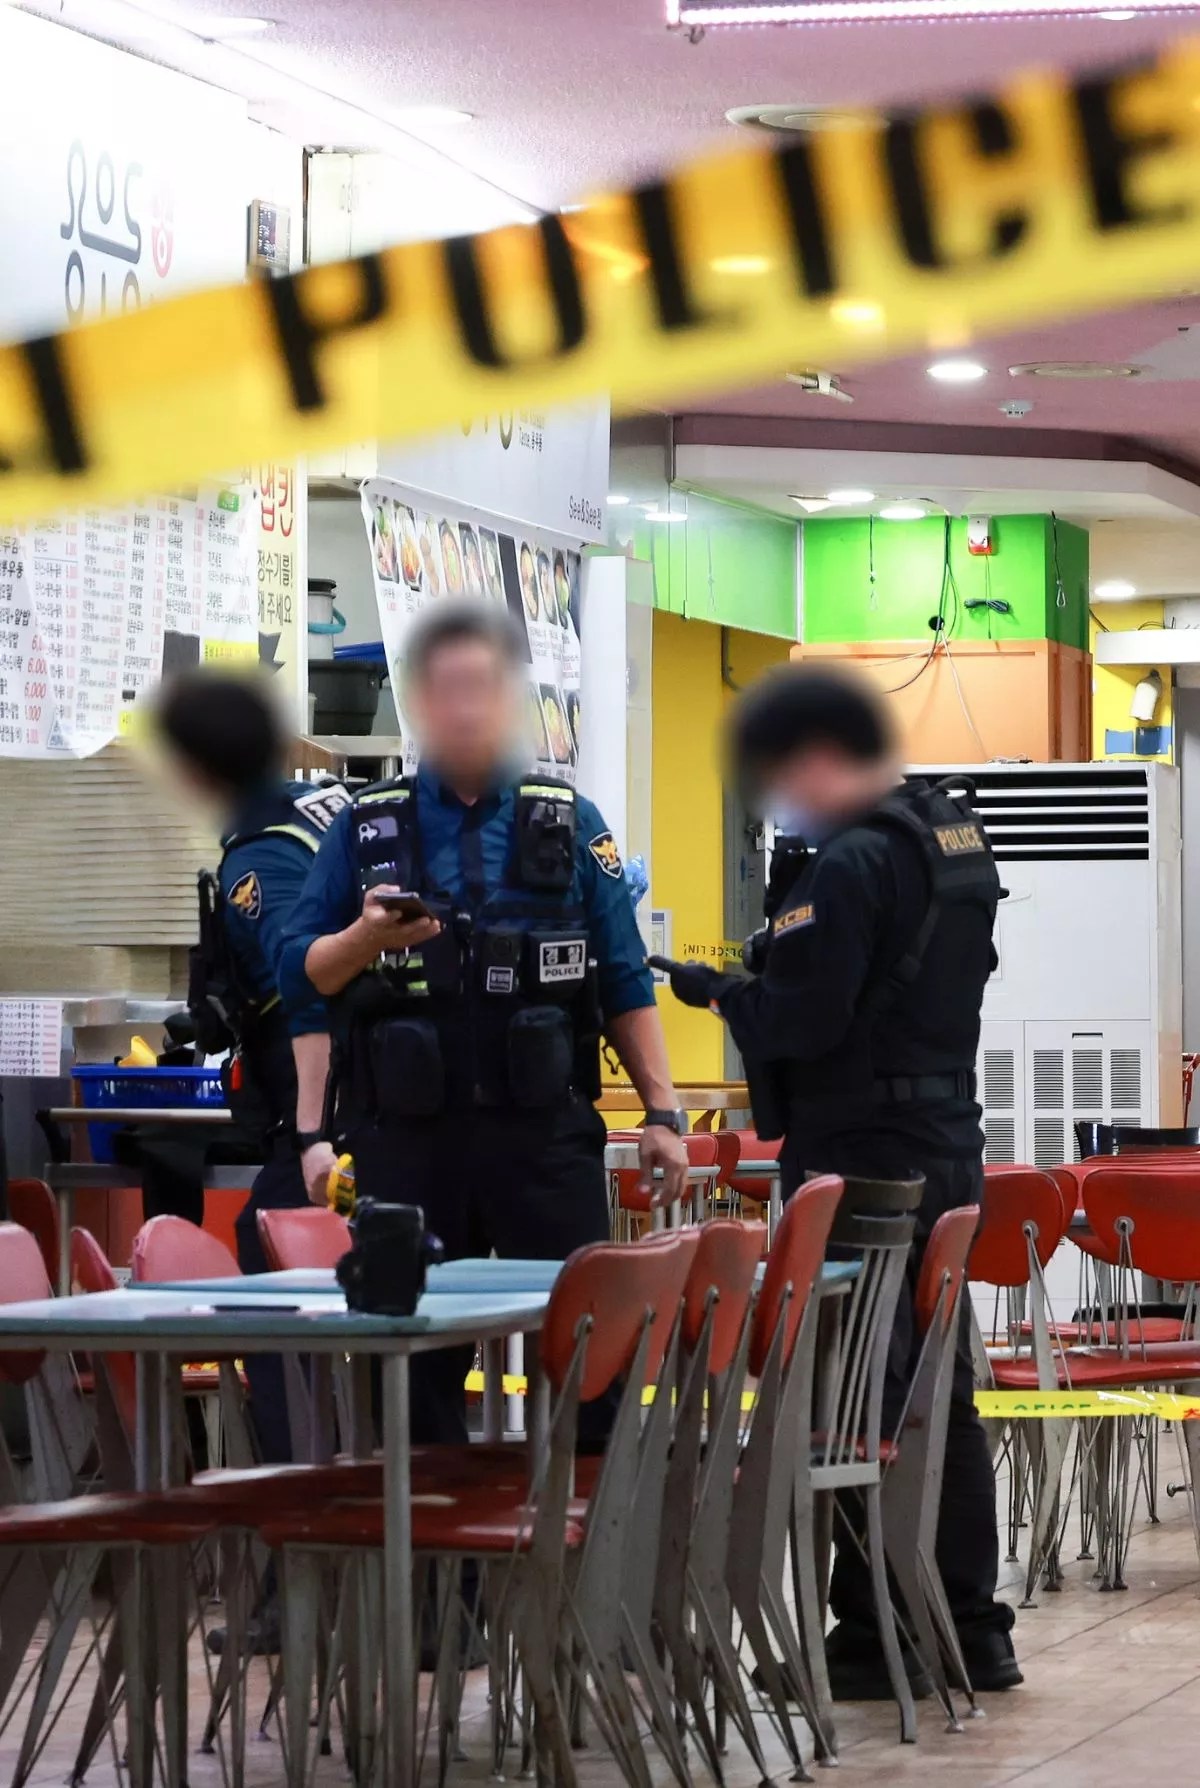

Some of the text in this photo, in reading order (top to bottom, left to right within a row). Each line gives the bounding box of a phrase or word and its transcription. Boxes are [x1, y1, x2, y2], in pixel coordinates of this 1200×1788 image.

[264, 52, 1193, 414] POLICE
[936, 826, 982, 851] POLICE
[544, 966, 580, 977] POLICE
